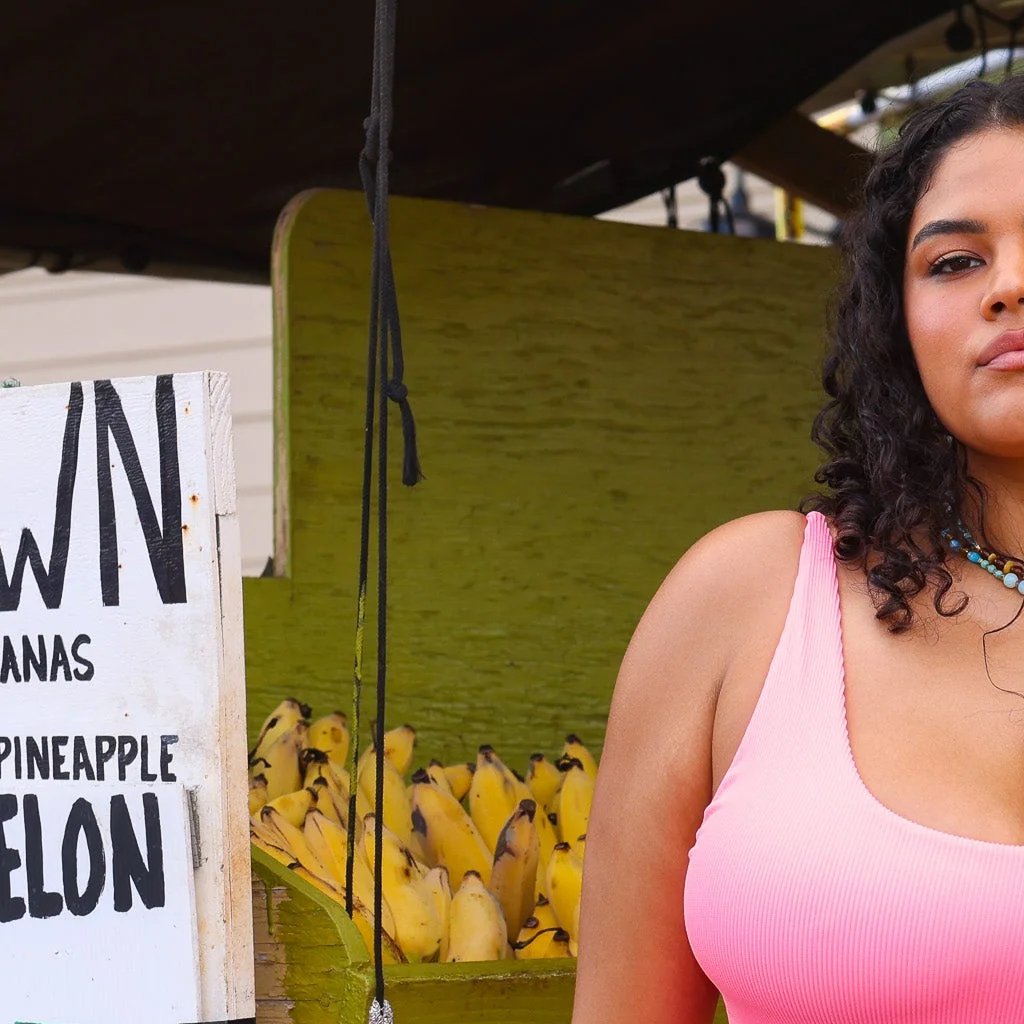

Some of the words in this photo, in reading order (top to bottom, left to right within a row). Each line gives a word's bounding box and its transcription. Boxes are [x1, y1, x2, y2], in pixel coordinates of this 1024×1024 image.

[0, 634, 95, 683] ANAS
[0, 735, 179, 782] PINEAPPLE
[0, 793, 166, 923] ELON
